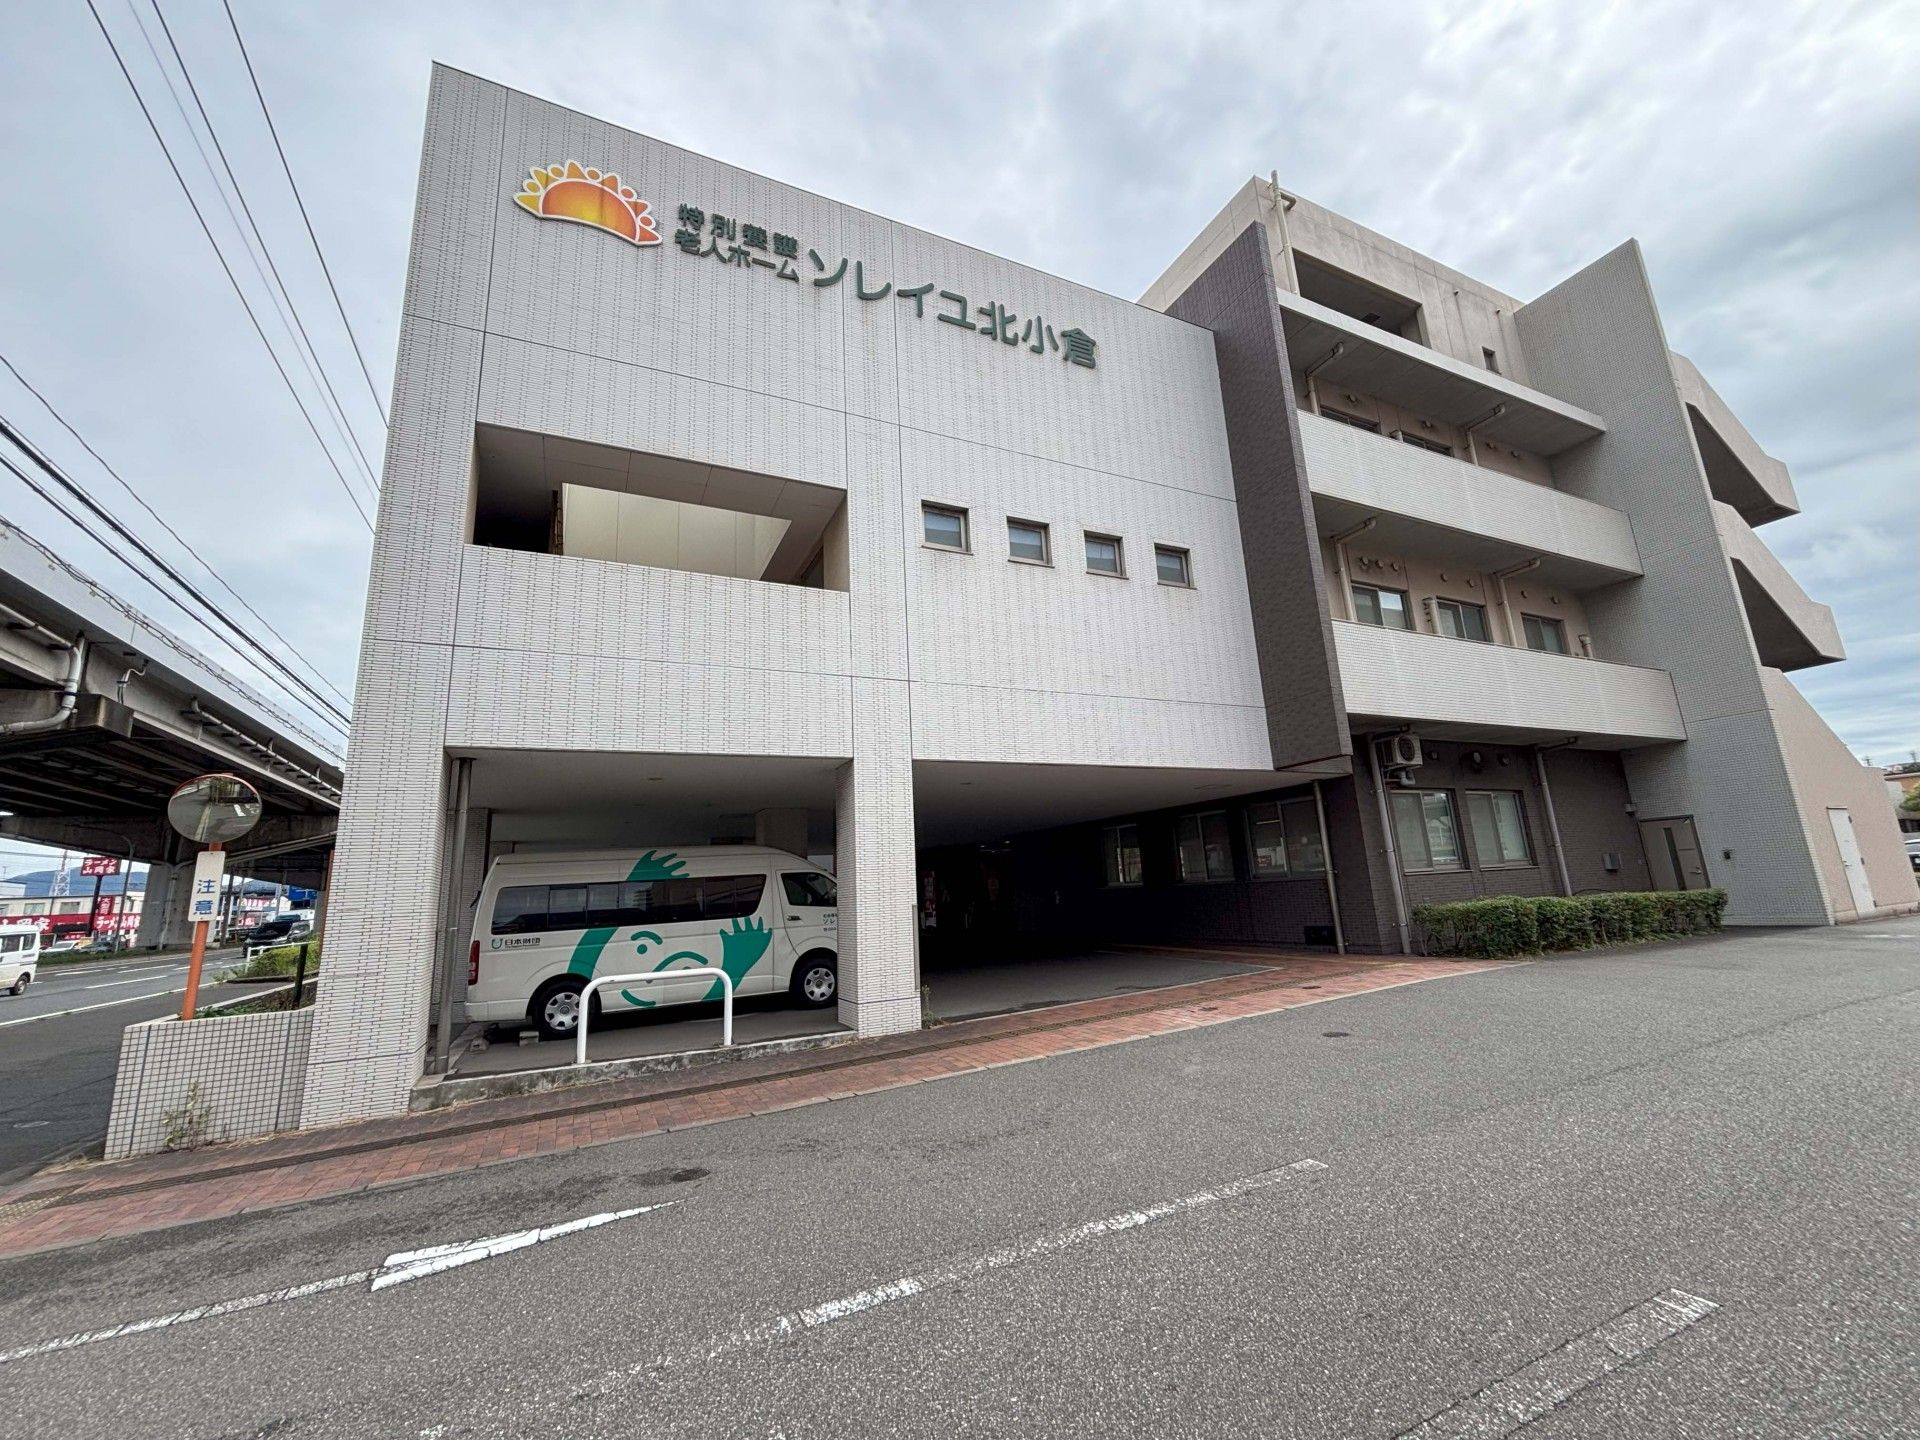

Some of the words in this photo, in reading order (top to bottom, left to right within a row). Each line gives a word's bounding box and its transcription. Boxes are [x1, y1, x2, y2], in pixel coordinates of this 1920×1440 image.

[678, 203, 798, 260] 特別養護
[674, 228, 799, 282] 老人ホーム
[808, 248, 1096, 369] ソレイユ北小倉
[84, 859, 117, 867] ラーメン
[193, 879, 216, 915] 注意
[504, 937, 541, 946] 日本財団
